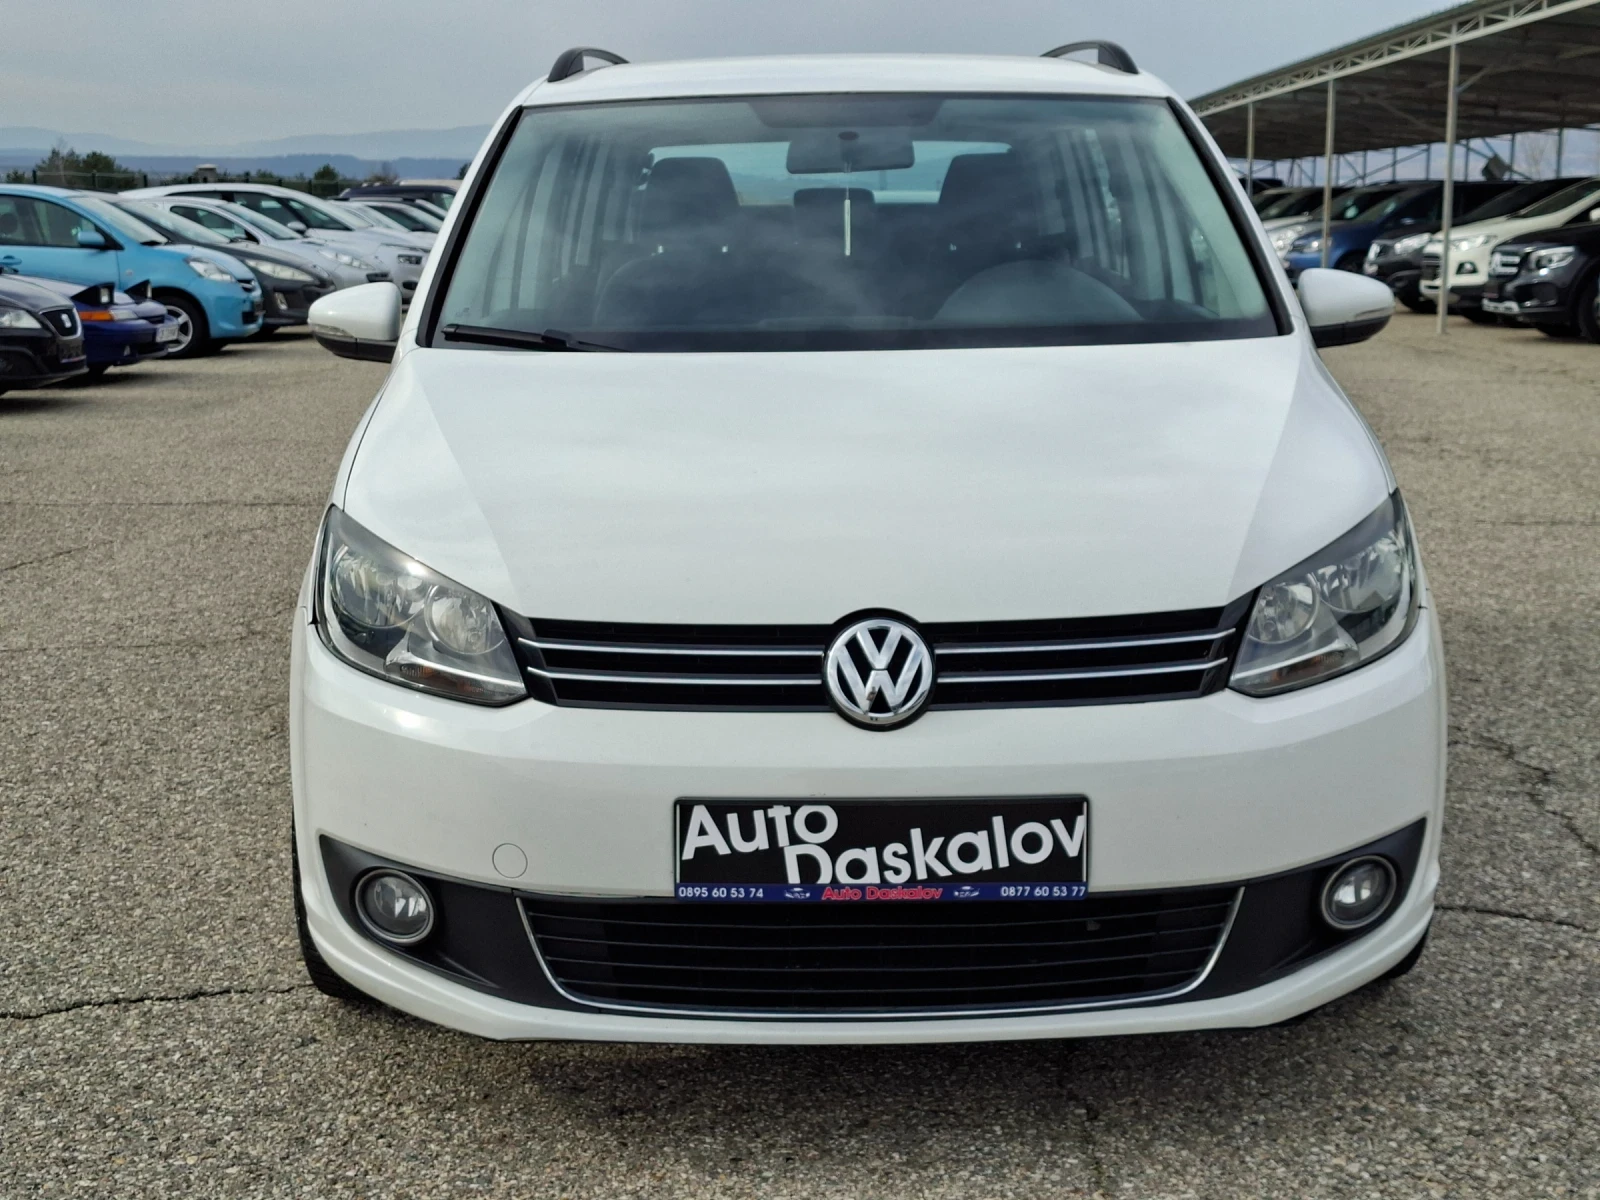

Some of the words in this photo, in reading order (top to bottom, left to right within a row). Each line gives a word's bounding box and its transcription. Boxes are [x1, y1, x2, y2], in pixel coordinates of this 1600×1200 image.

[682, 804, 838, 860] Auto
[783, 815, 1086, 884] Daskalov
[678, 886, 708, 898] 0895
[711, 887, 727, 898] 60
[730, 887, 745, 898] 53
[749, 887, 764, 898] 74
[821, 886, 862, 900] Auto
[866, 885, 943, 900] Daskalov
[1001, 886, 1030, 897] 0877
[1033, 886, 1050, 897] 60
[1052, 886, 1067, 897] 53
[1071, 886, 1086, 897] 77
